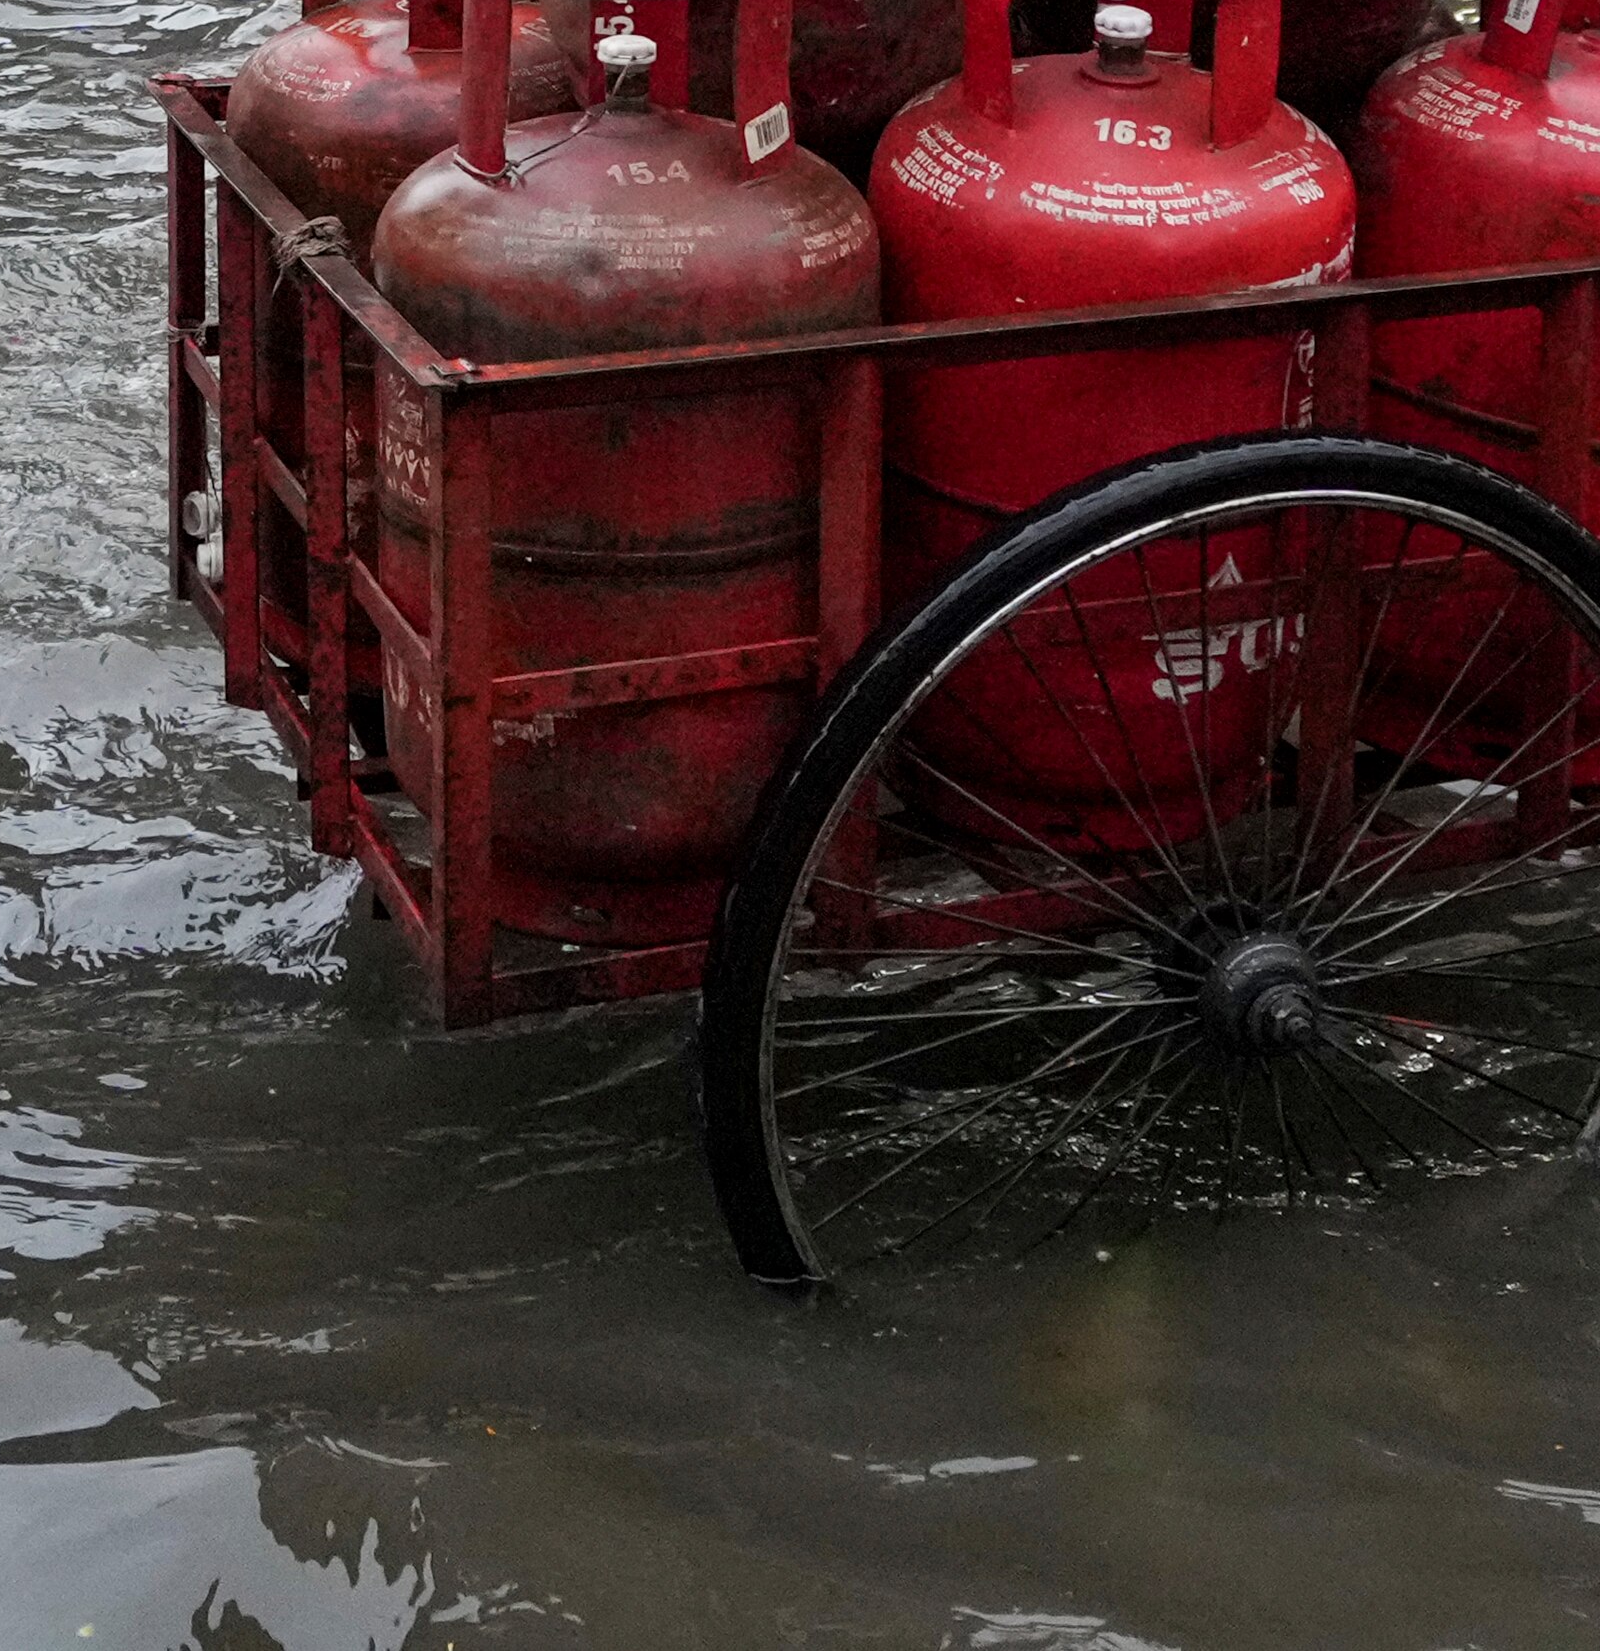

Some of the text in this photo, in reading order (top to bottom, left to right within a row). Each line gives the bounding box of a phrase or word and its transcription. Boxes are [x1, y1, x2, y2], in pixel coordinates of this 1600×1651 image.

[1455, 107, 1481, 119] OFF
[1094, 117, 1172, 151] 16.3
[606, 160, 691, 187] 15.4
[903, 155, 956, 199] REGULATOR
[942, 171, 967, 188] OFF
[1288, 177, 1325, 206] 1906
